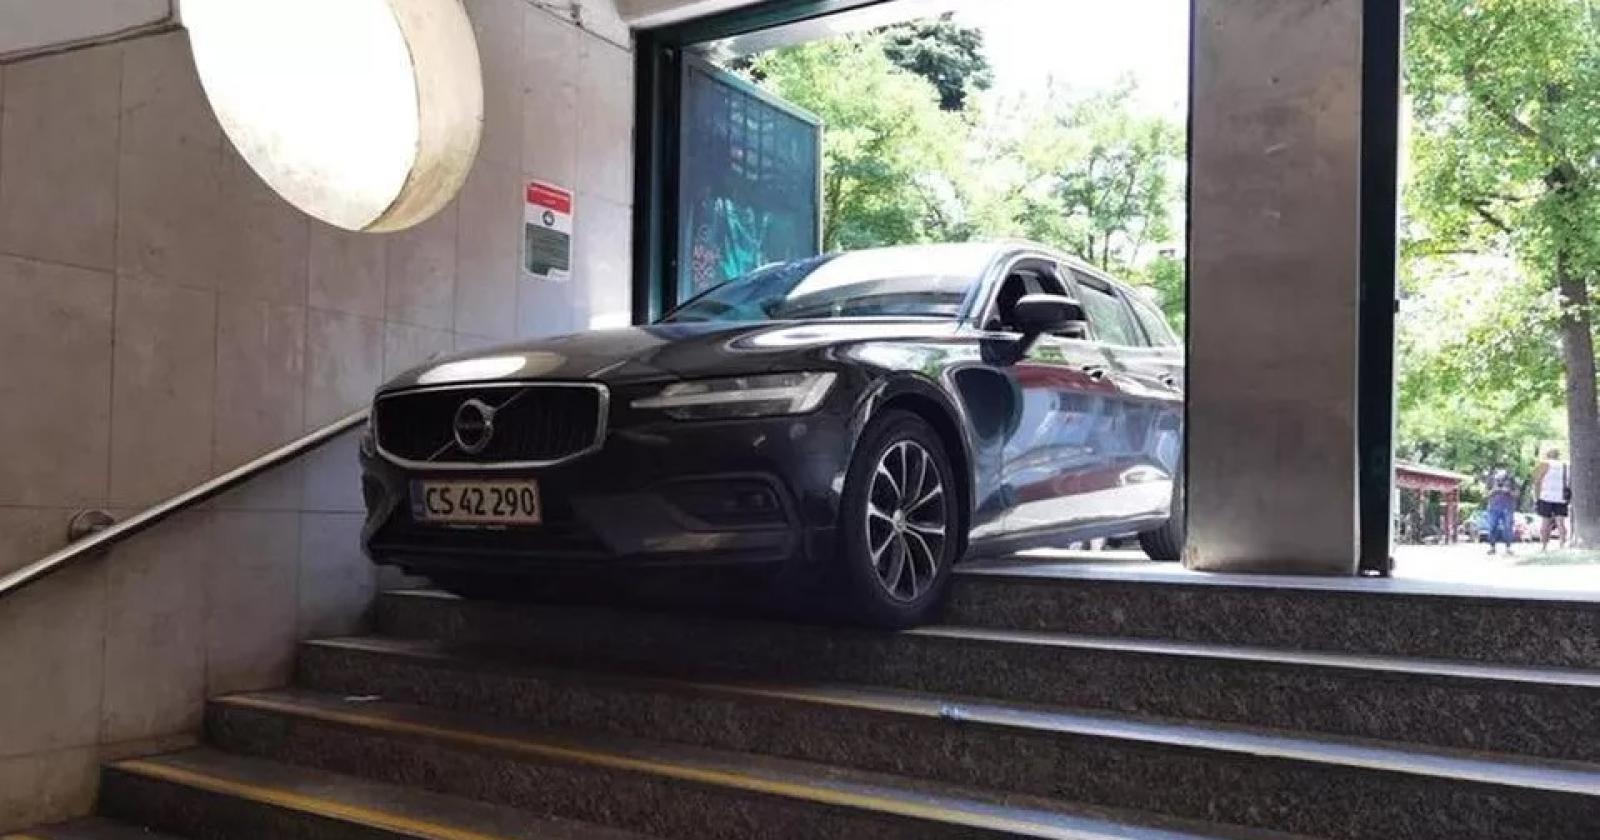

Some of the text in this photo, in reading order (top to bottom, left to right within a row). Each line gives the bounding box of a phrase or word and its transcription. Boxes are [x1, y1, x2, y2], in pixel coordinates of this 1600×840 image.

[426, 487, 454, 515] CS
[459, 487, 486, 516] 42
[491, 487, 535, 517] 290
